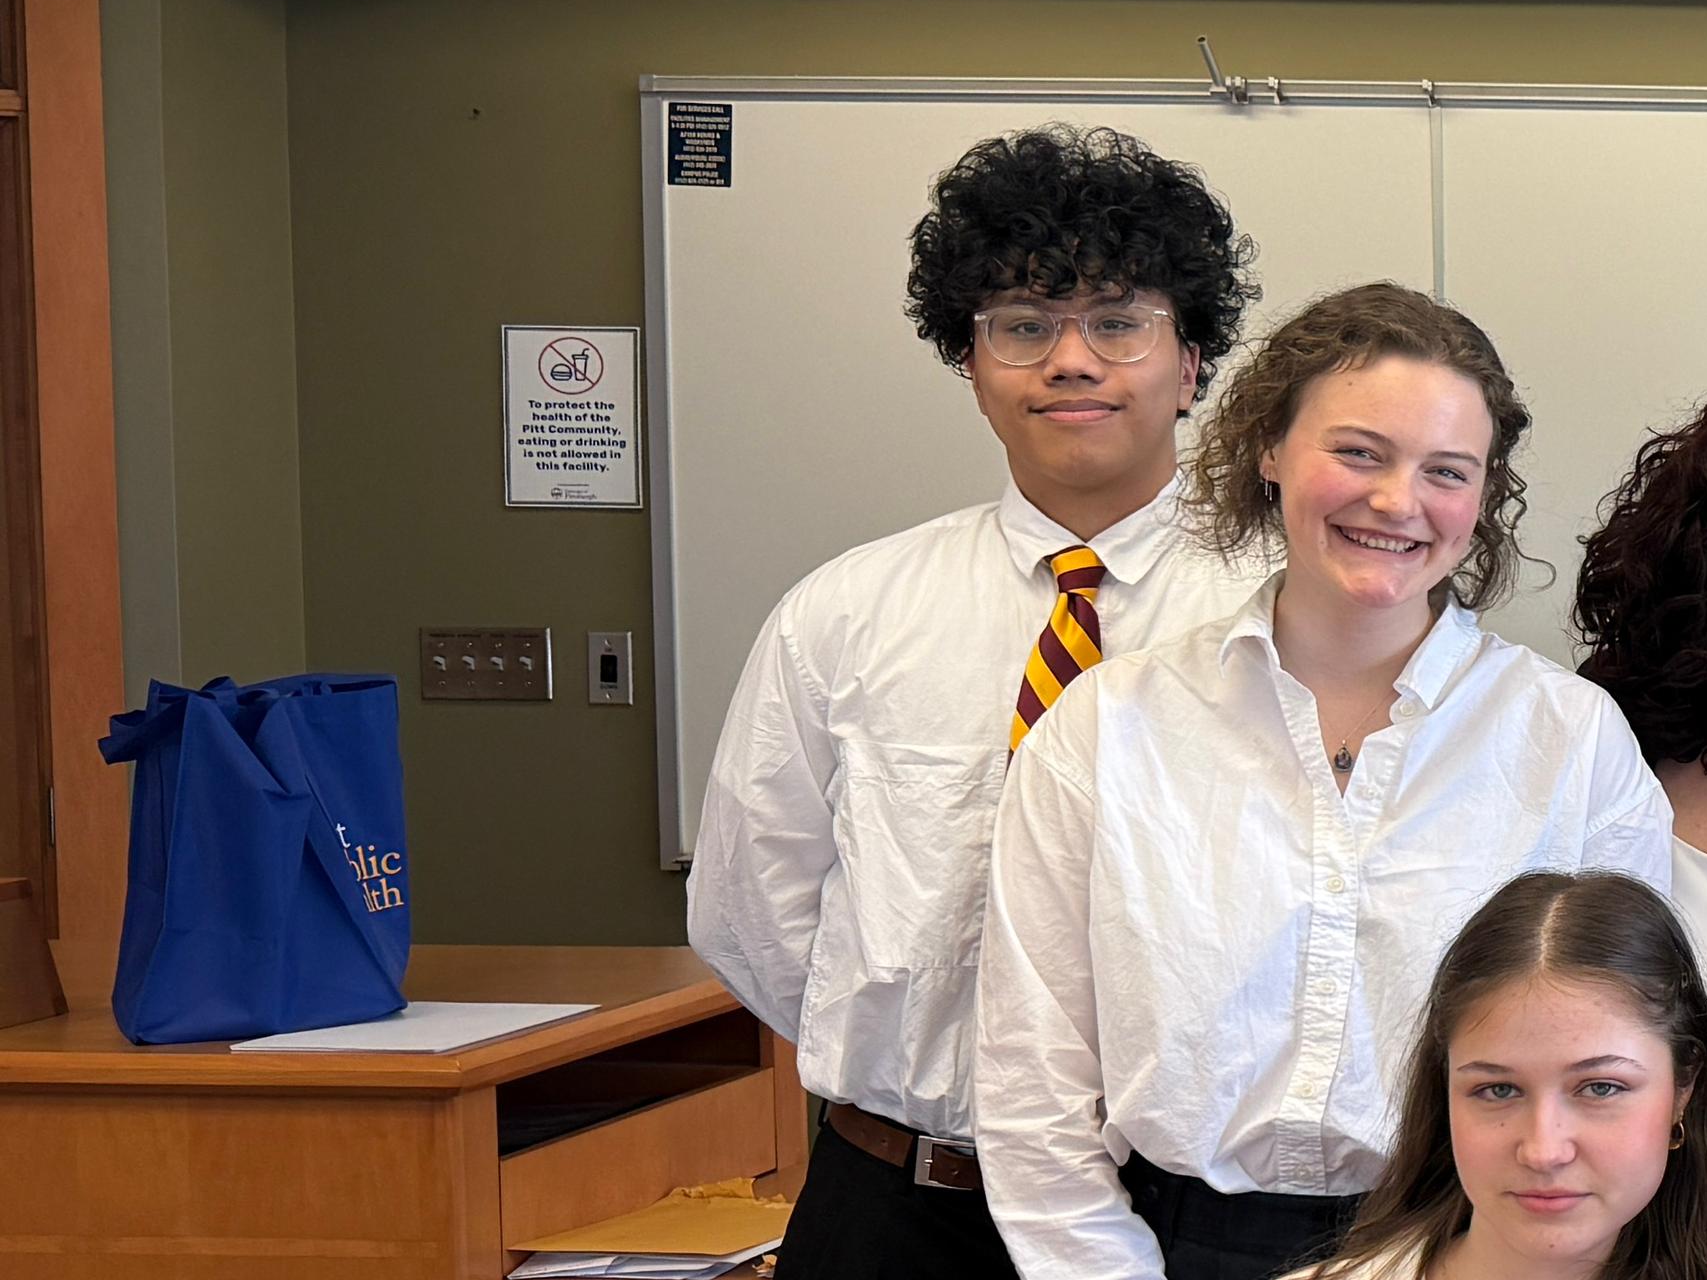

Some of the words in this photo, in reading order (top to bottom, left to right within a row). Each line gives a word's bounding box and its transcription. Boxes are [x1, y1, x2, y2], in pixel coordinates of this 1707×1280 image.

[528, 400, 542, 409] To
[545, 401, 592, 410] protect
[594, 401, 615, 410] the
[532, 413, 572, 421] health
[575, 413, 588, 421] of
[590, 413, 611, 422] the
[522, 425, 546, 433] Pitt
[548, 425, 621, 436] Community,
[518, 437, 557, 447] eating
[575, 438, 627, 449] drinking
[523, 449, 534, 458] is
[537, 450, 557, 458] not
[561, 450, 607, 459] allowed
[610, 450, 621, 459] in
[536, 461, 560, 470] this
[563, 462, 610, 472] facility.
